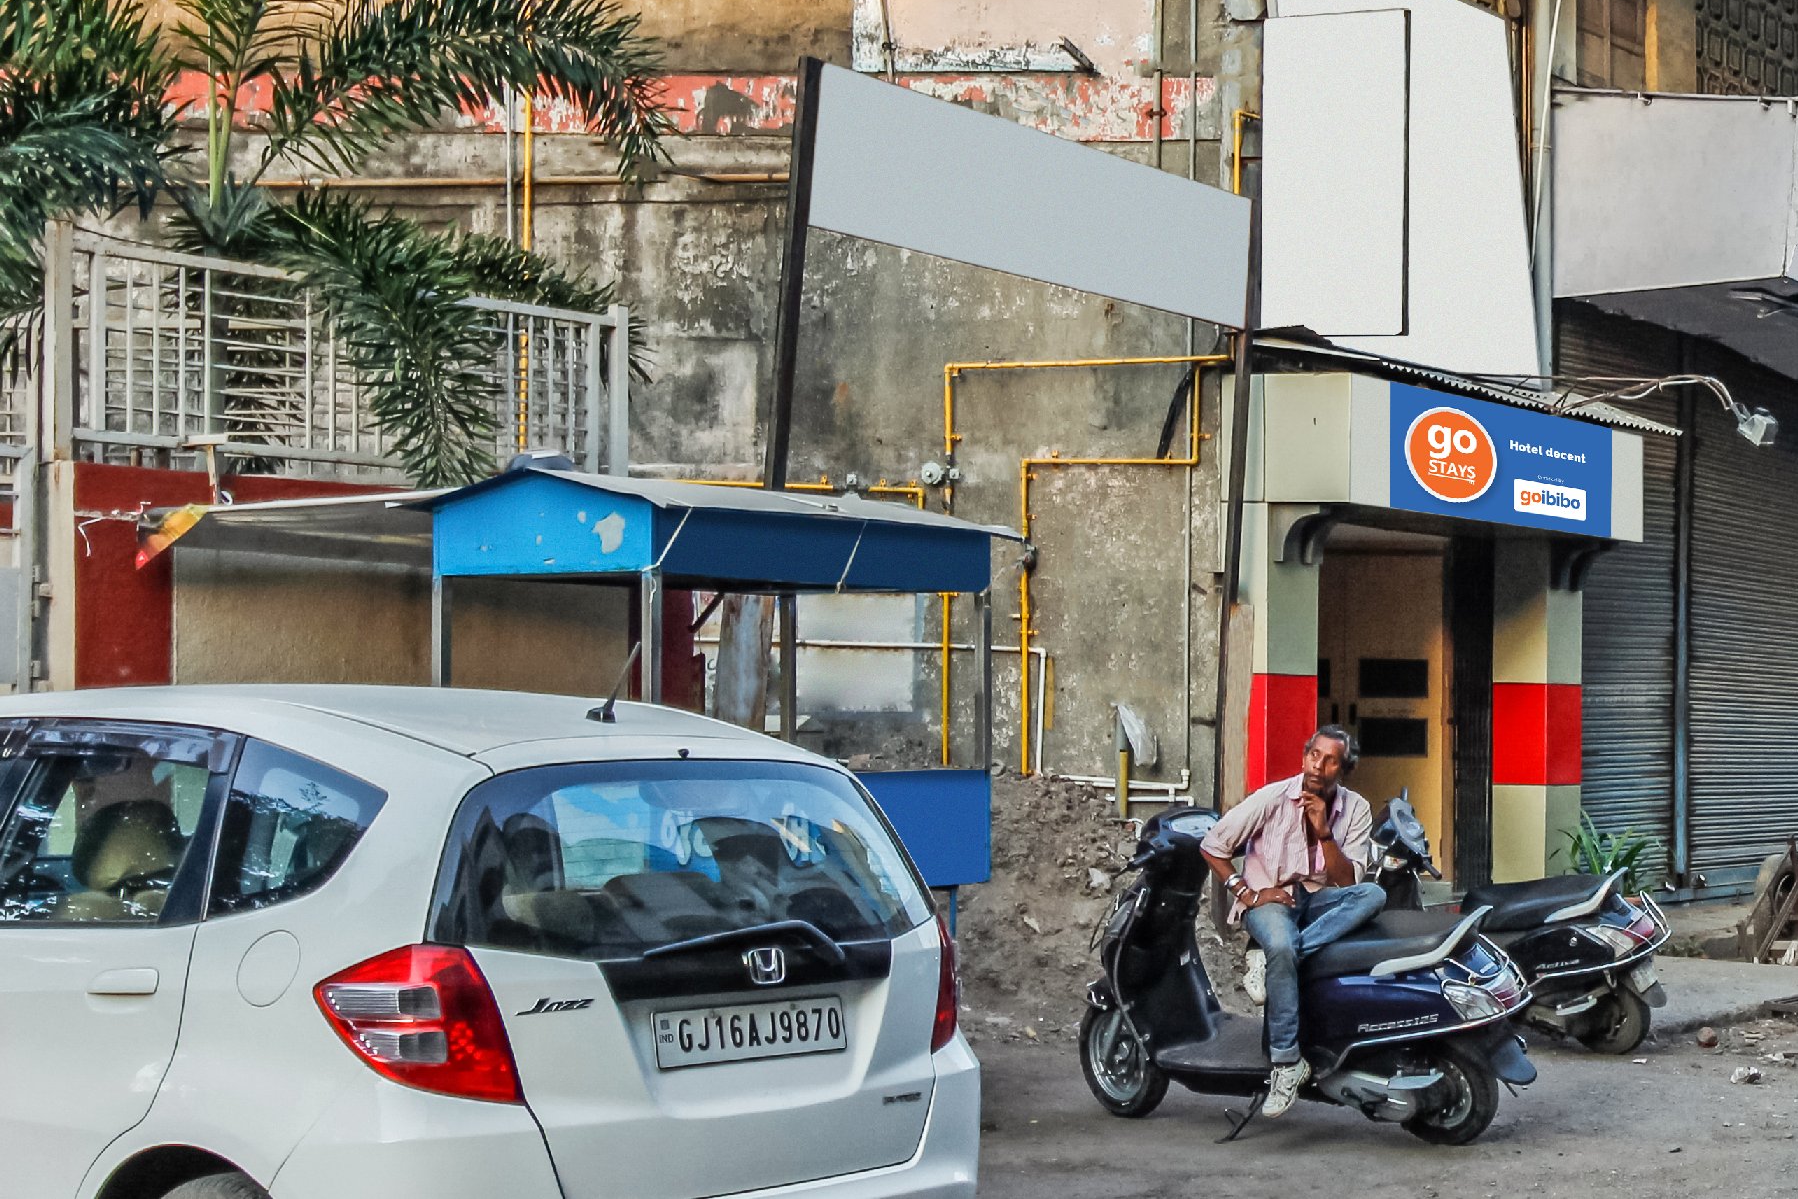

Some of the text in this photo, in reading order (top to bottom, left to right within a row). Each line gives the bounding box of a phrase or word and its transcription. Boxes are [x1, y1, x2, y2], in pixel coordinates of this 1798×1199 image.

[1428, 424, 1477, 459] go
[1509, 439, 1587, 464] Hotel decent
[1428, 459, 1476, 480] STAYS
[1520, 489, 1581, 509] goibibo
[514, 997, 595, 1016] Jazz
[659, 1033, 674, 1043] IND
[678, 1007, 841, 1053] GJ16AJ9870
